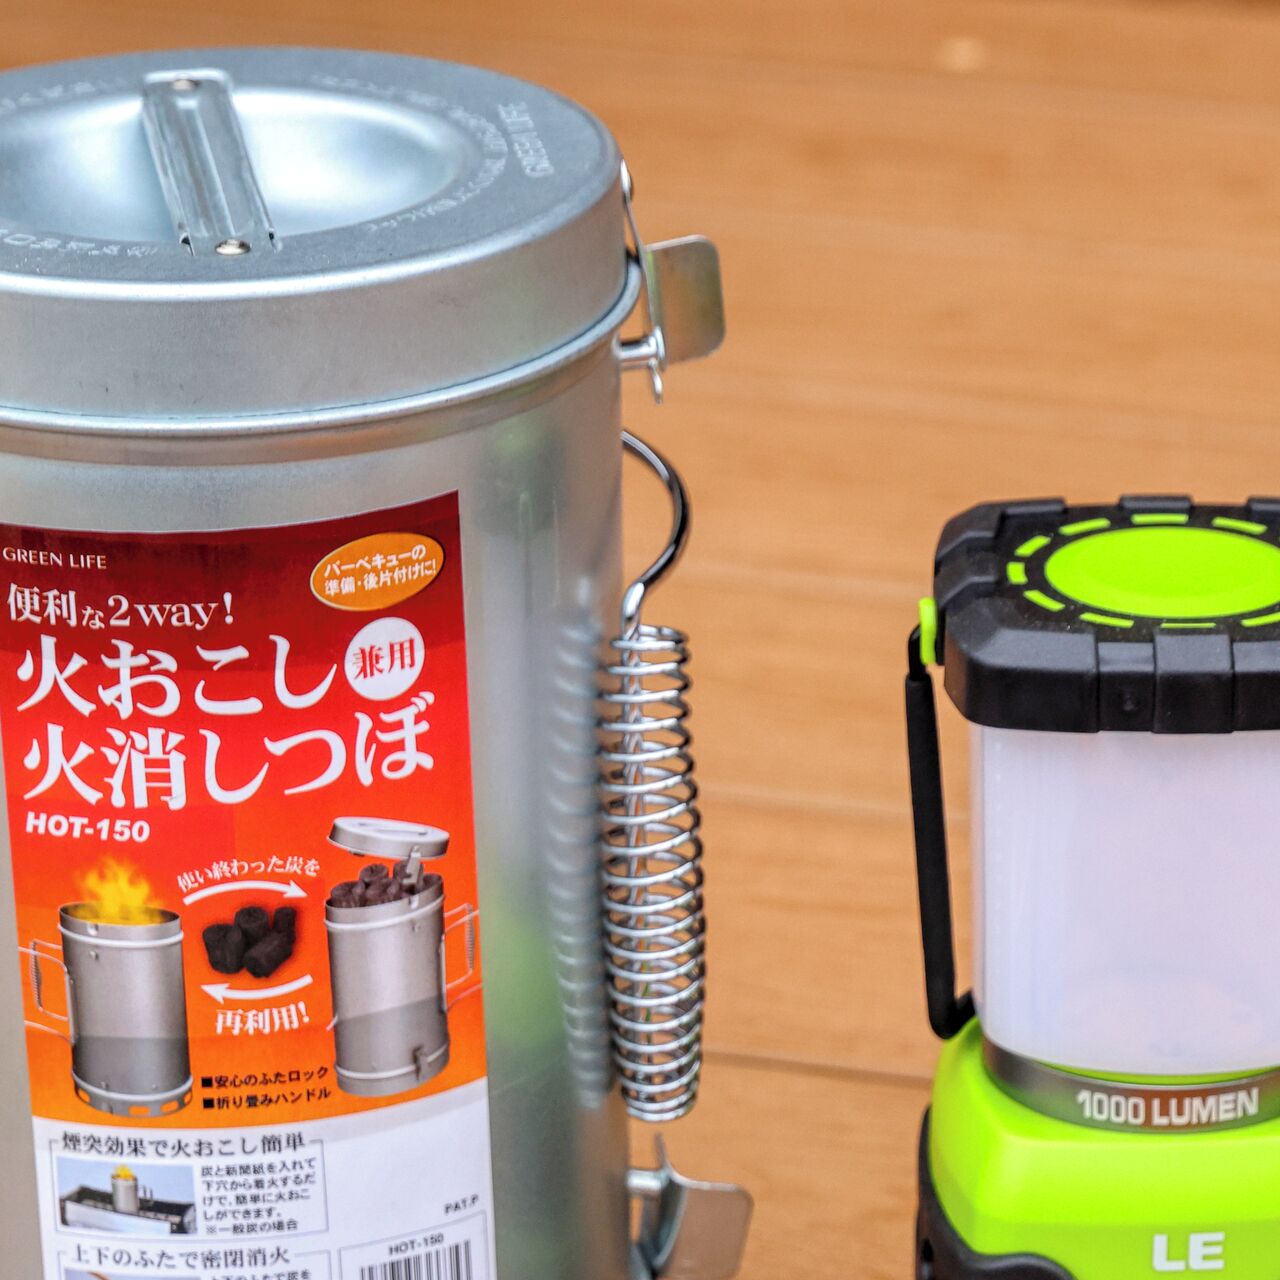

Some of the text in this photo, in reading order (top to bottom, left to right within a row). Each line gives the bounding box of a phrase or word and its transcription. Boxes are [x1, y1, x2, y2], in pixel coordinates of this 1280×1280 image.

[3, 546, 107, 570] GREEN LIFE
[324, 544, 426, 578] バーベキューの
[16, 633, 418, 719] 火おこし 兼用
[22, 690, 436, 811] 火消しつぼ
[25, 811, 150, 843] HOT-150
[176, 855, 321, 893] 使い終わった炭を
[215, 1000, 310, 1037] 再利用!
[1076, 1087, 1260, 1126] 1000 LUMEN
[62, 1131, 306, 1158] 煙突効果で火おこし簡単
[201, 1157, 316, 1177] 炭と新聞紙を入れて
[73, 1242, 290, 1270] 上下のふたで密閉消火
[388, 1232, 444, 1256] HOT-150
[1152, 1231, 1225, 1272] LE
